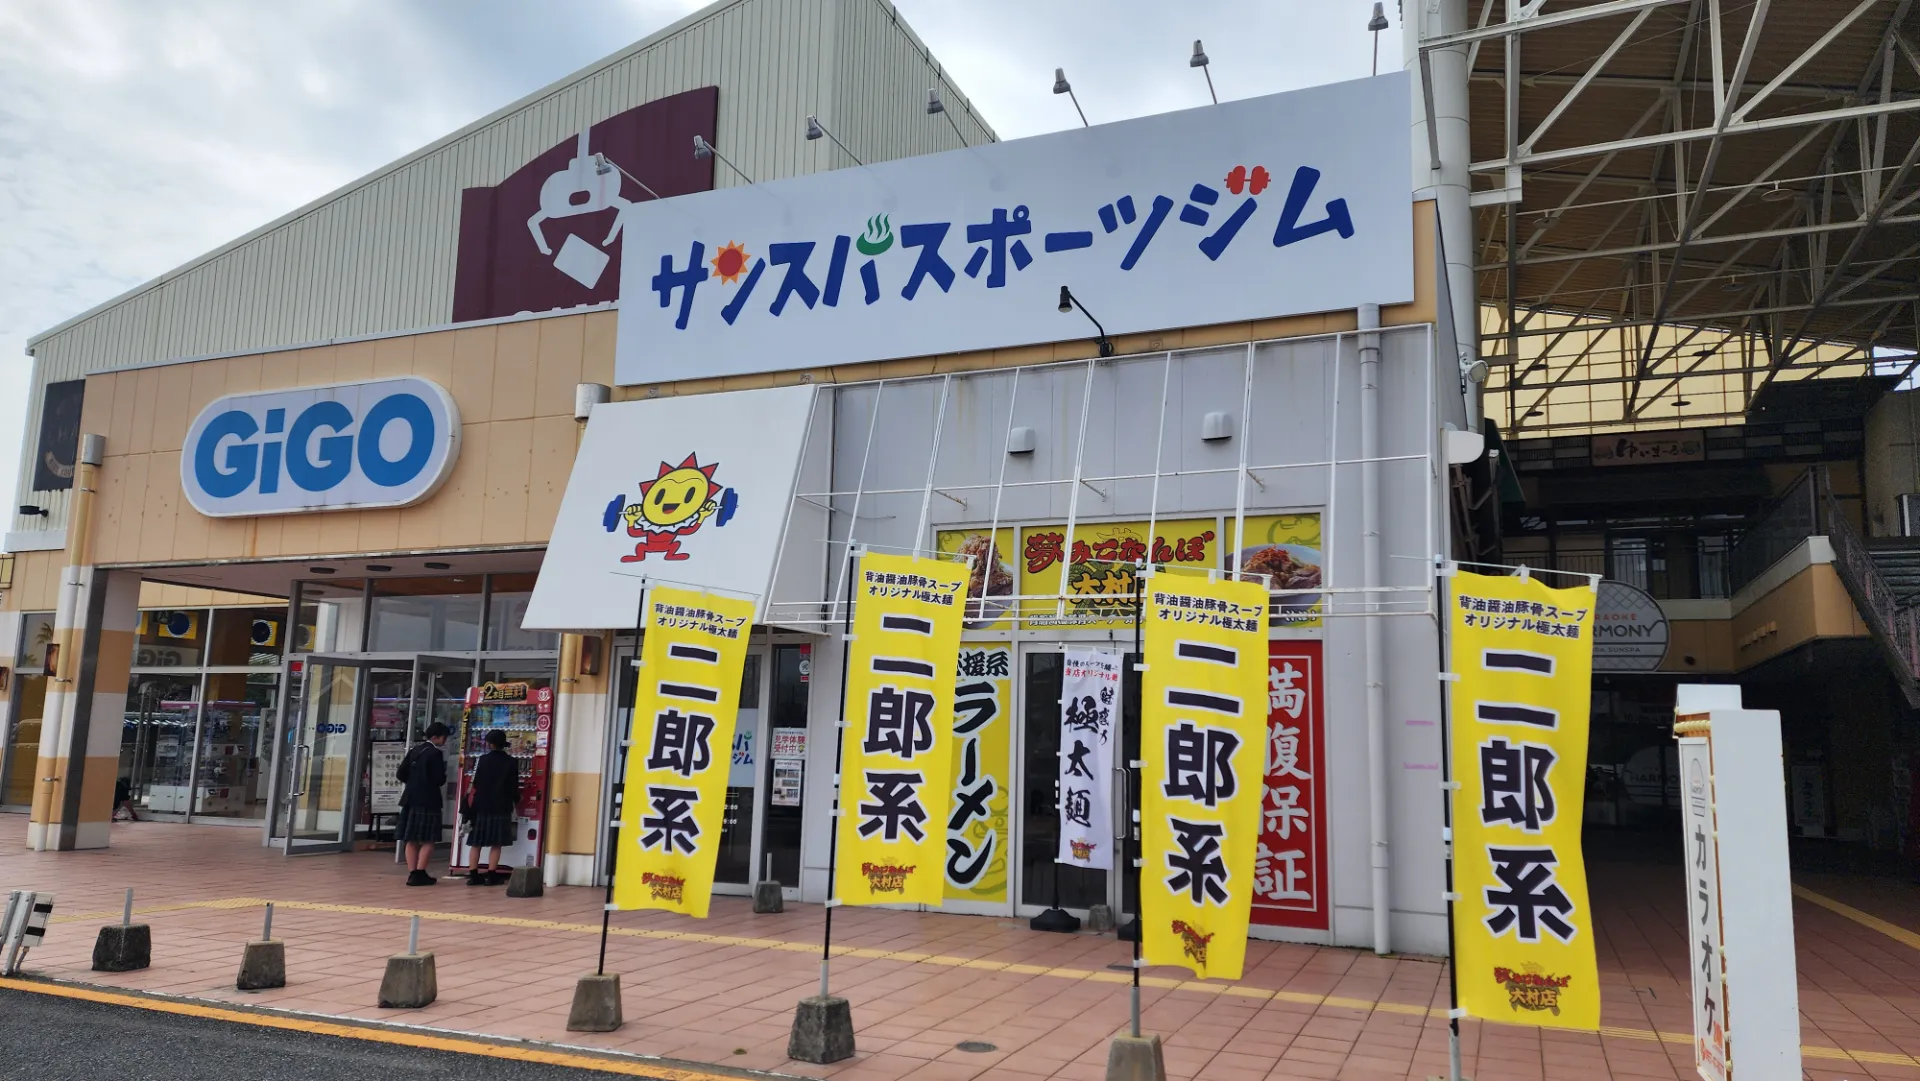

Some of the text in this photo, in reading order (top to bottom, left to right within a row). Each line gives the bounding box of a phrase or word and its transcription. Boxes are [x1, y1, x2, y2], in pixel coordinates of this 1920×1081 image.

[652, 165, 1355, 330] サンスパスポーツジム
[194, 393, 435, 498] GiGO
[869, 585, 954, 606] オリジナル極太麺
[1159, 608, 1258, 632] オリジナル極太麺
[1465, 613, 1580, 639] オリジナル極太麺
[1593, 624, 1653, 638] MONY
[1595, 613, 1637, 621] RAOKE
[640, 644, 719, 856] 二郎系
[858, 615, 936, 842] 二郎系
[946, 680, 997, 885] ラーメン
[1163, 639, 1242, 905] 二郎系
[1478, 650, 1575, 943] 二郎系
[1695, 824, 1716, 1034] カラオケ
[1509, 987, 1558, 1007] 大村店
